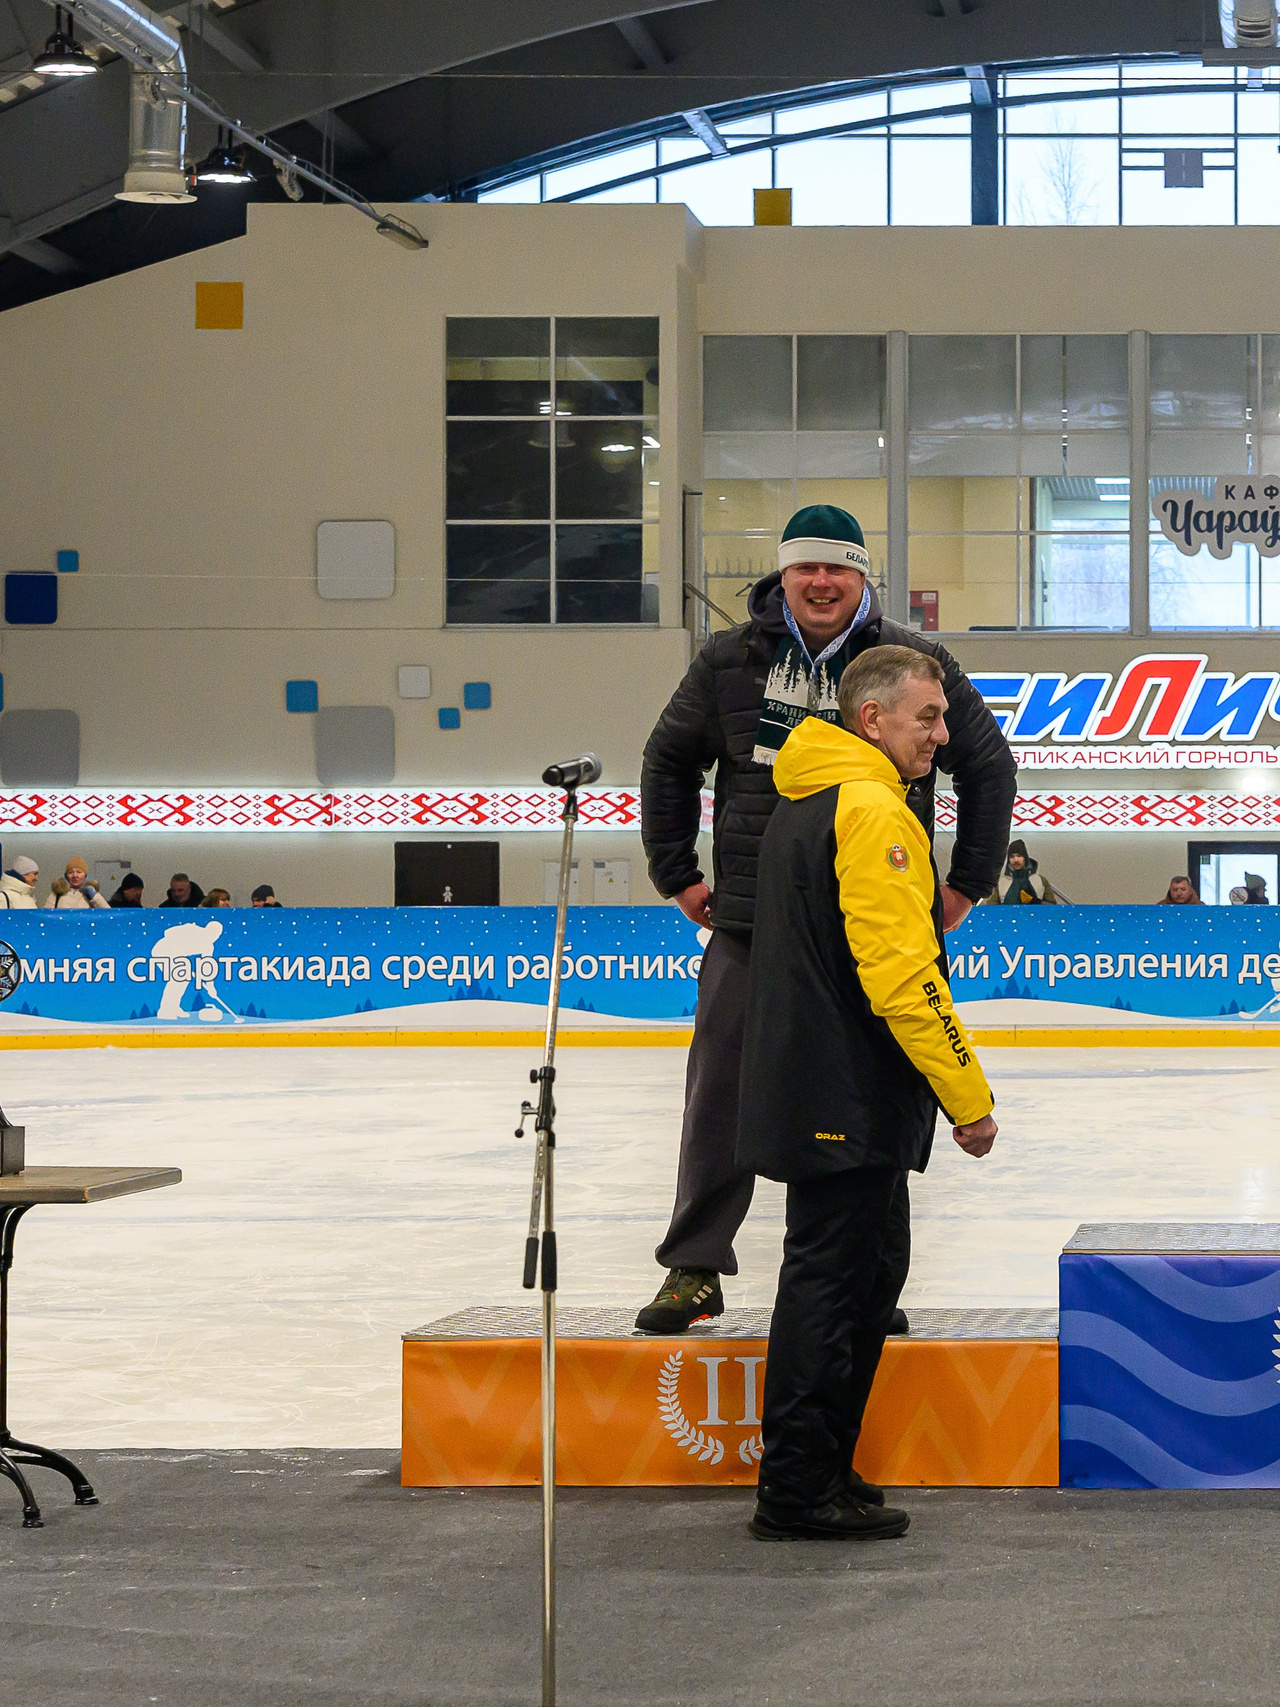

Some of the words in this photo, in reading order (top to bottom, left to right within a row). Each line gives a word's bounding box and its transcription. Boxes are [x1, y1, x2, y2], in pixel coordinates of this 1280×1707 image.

[766, 701, 837, 721] ХРАНИЕЛИ
[126, 954, 372, 990] спартакиада
[381, 953, 496, 989] среди
[998, 945, 1228, 987] Управления
[815, 1132, 846, 1141] ORAZ
[696, 1356, 766, 1425] II
